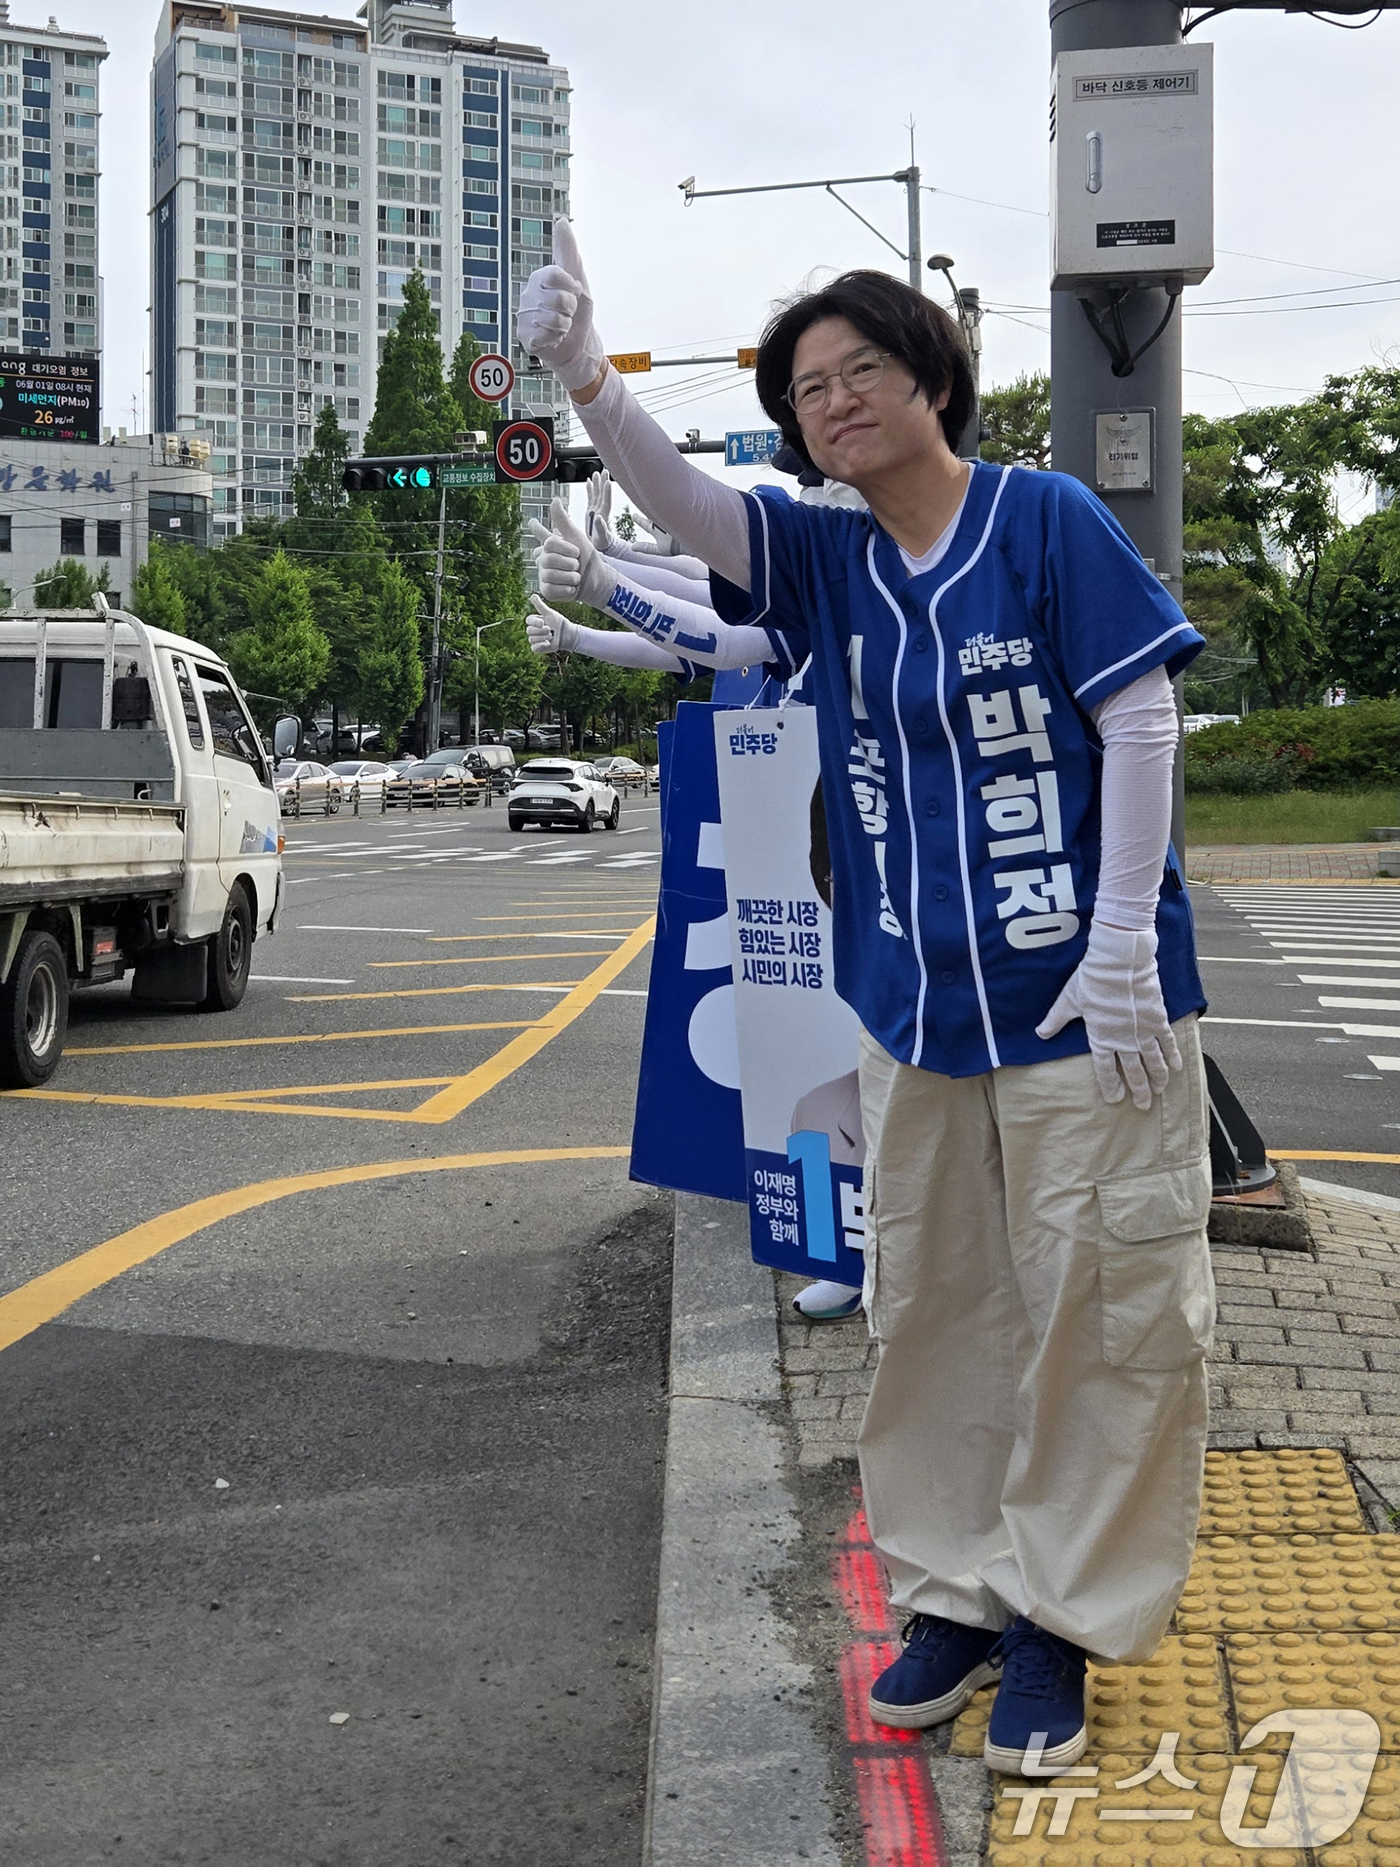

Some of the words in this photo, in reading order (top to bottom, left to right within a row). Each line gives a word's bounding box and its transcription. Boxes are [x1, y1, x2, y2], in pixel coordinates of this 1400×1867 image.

[1083, 81, 1107, 93] 바닥
[1111, 80, 1148, 92] 신호등
[1153, 76, 1189, 89] 제어기
[71, 366, 88, 376] 정보
[481, 368, 504, 387] 50
[34, 410, 53, 424] 26
[509, 437, 539, 464] 50
[673, 630, 717, 654] 1
[964, 632, 995, 647] 더불어
[958, 637, 1034, 676] 민주당
[847, 634, 869, 720] 1
[729, 733, 778, 755] 민주당
[966, 684, 1081, 950] 박희정
[736, 899, 783, 925] 깨끗한
[787, 901, 819, 927] 시장
[738, 928, 785, 955] 힘있는
[789, 931, 821, 958] 시장
[742, 958, 787, 986] 시민의
[791, 962, 823, 989] 시장
[754, 1169, 796, 1197] 이재명
[786, 1129, 837, 1263] 1
[756, 1193, 799, 1221] 정부와
[769, 1219, 799, 1246] 함께
